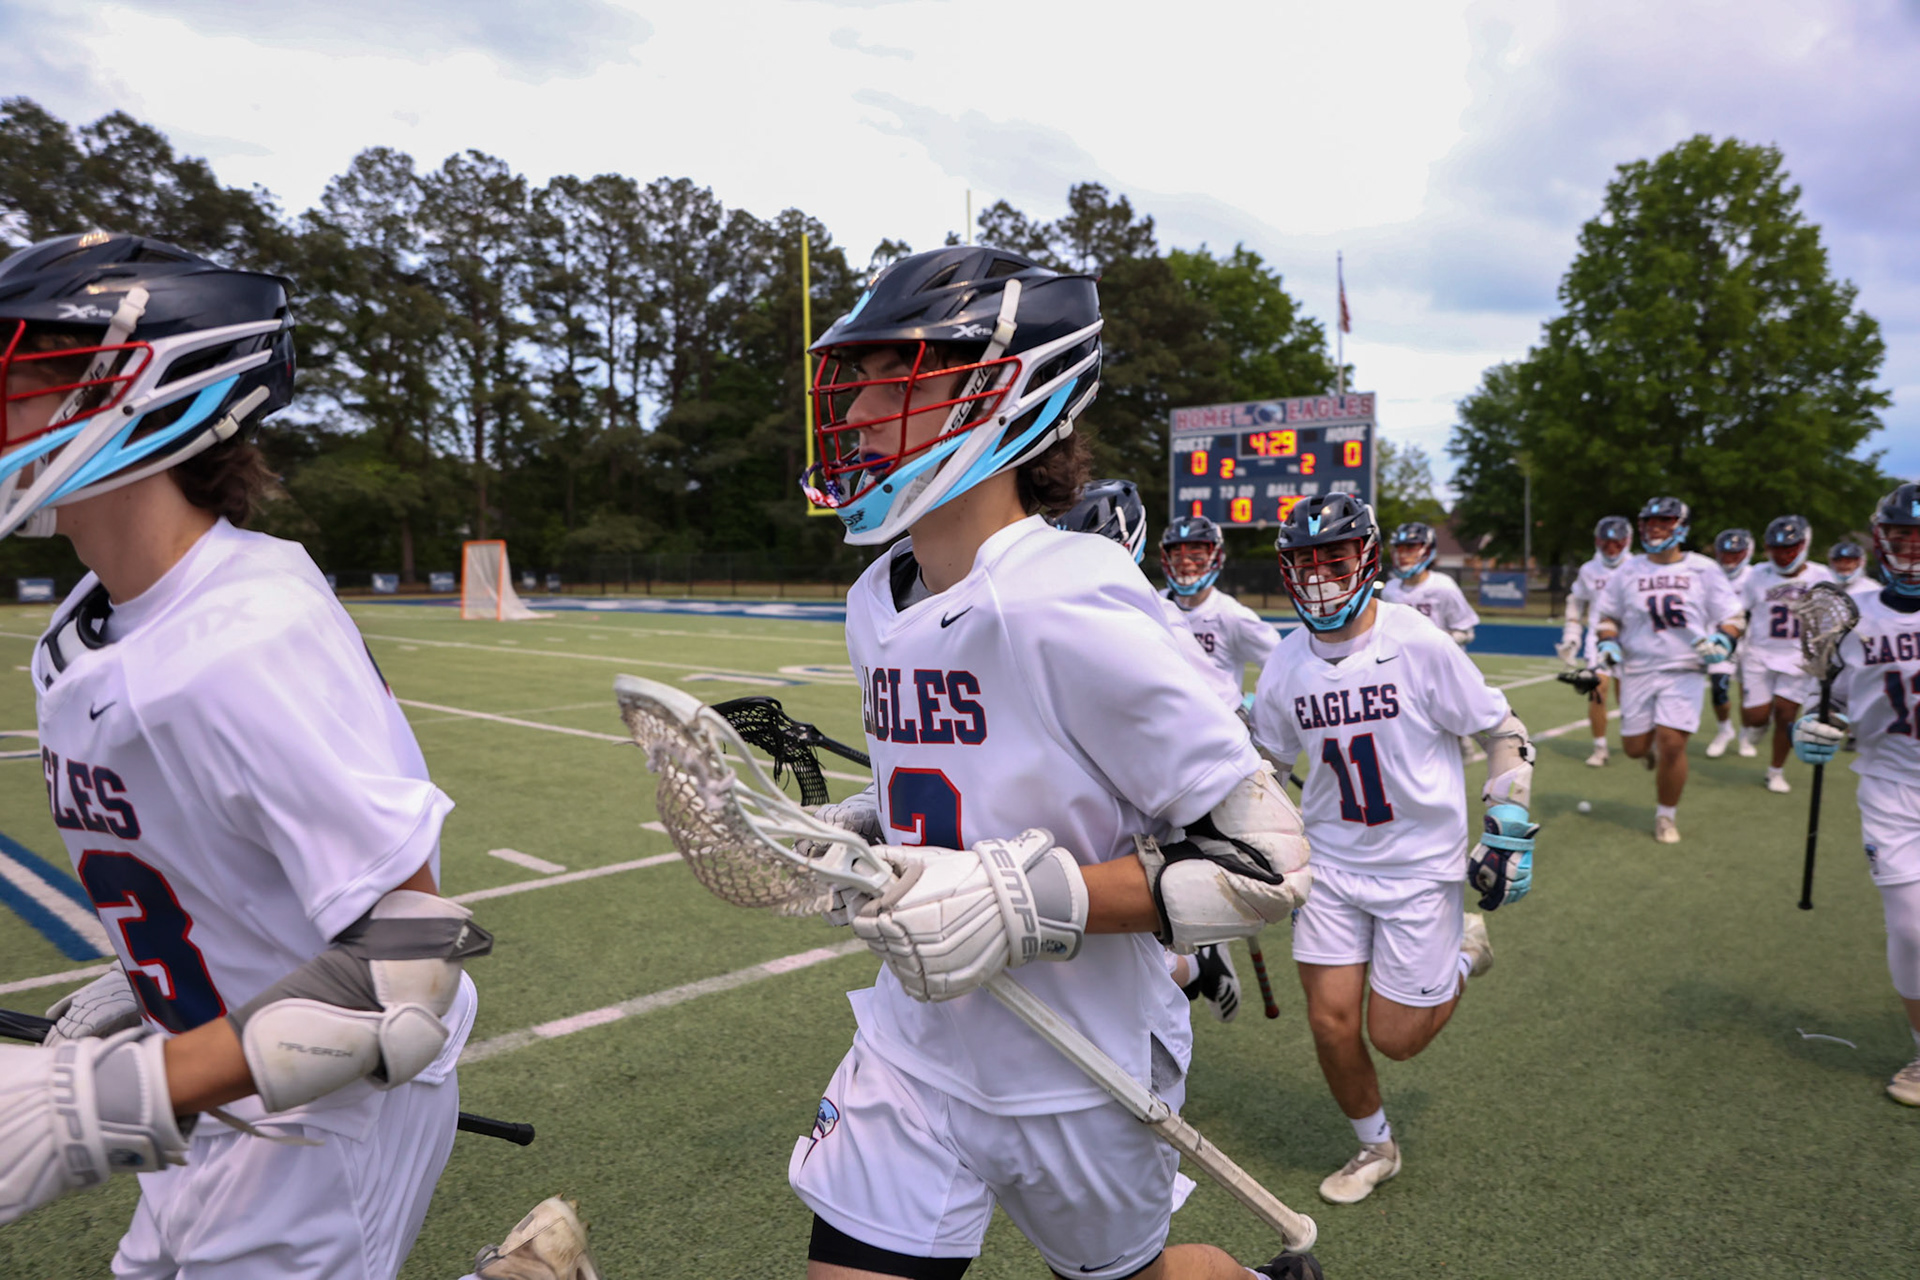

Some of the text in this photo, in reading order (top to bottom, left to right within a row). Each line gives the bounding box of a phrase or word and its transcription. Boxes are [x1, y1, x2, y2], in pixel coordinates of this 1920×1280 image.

[1175, 408, 1233, 431] HOME
[1286, 396, 1373, 421] EAGLES
[1191, 450, 1208, 475] 0
[1220, 458, 1236, 479] 2
[1300, 453, 1316, 475] 2
[1343, 440, 1362, 467] 0
[1637, 574, 1691, 592] EAGLES
[1646, 594, 1687, 633] 16
[1294, 683, 1400, 730] EAGLES
[1322, 732, 1394, 827] 11
[78, 850, 227, 1034] 3
